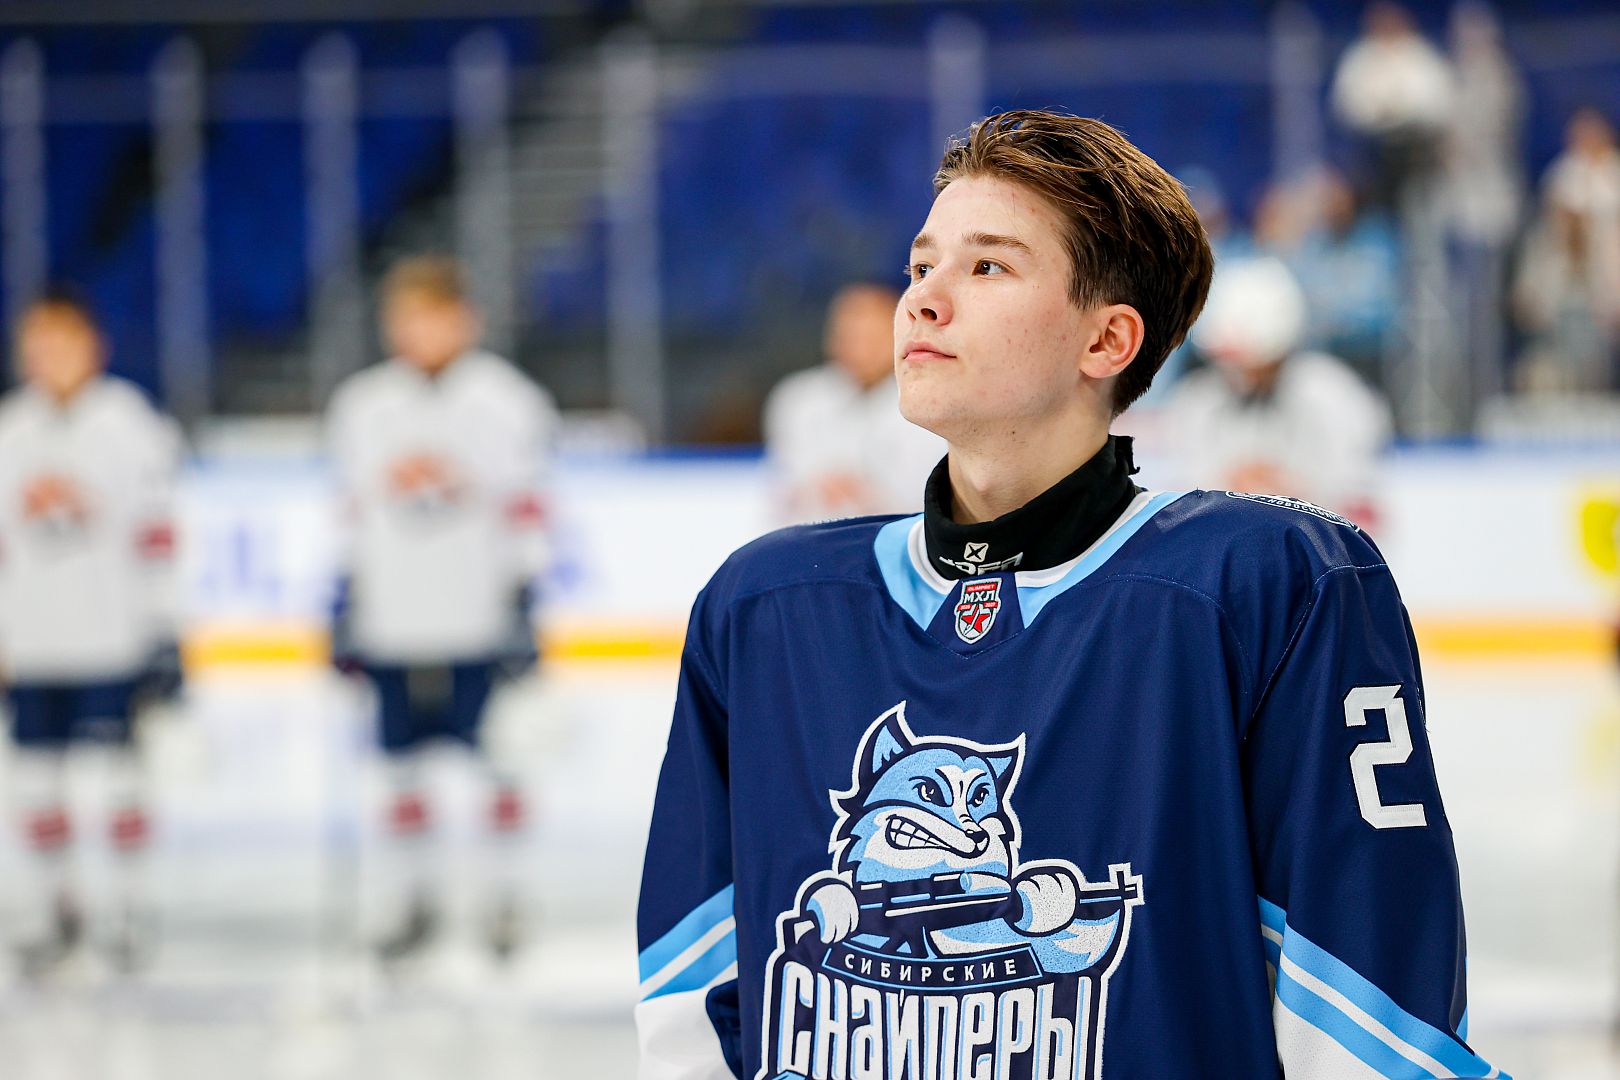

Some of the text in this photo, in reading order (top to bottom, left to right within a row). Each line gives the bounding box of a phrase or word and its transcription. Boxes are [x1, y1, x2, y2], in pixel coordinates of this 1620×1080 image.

[963, 590, 996, 603] МХЛ
[1344, 684, 1427, 829] 2
[844, 953, 1018, 983] СИБИРСКИЕ
